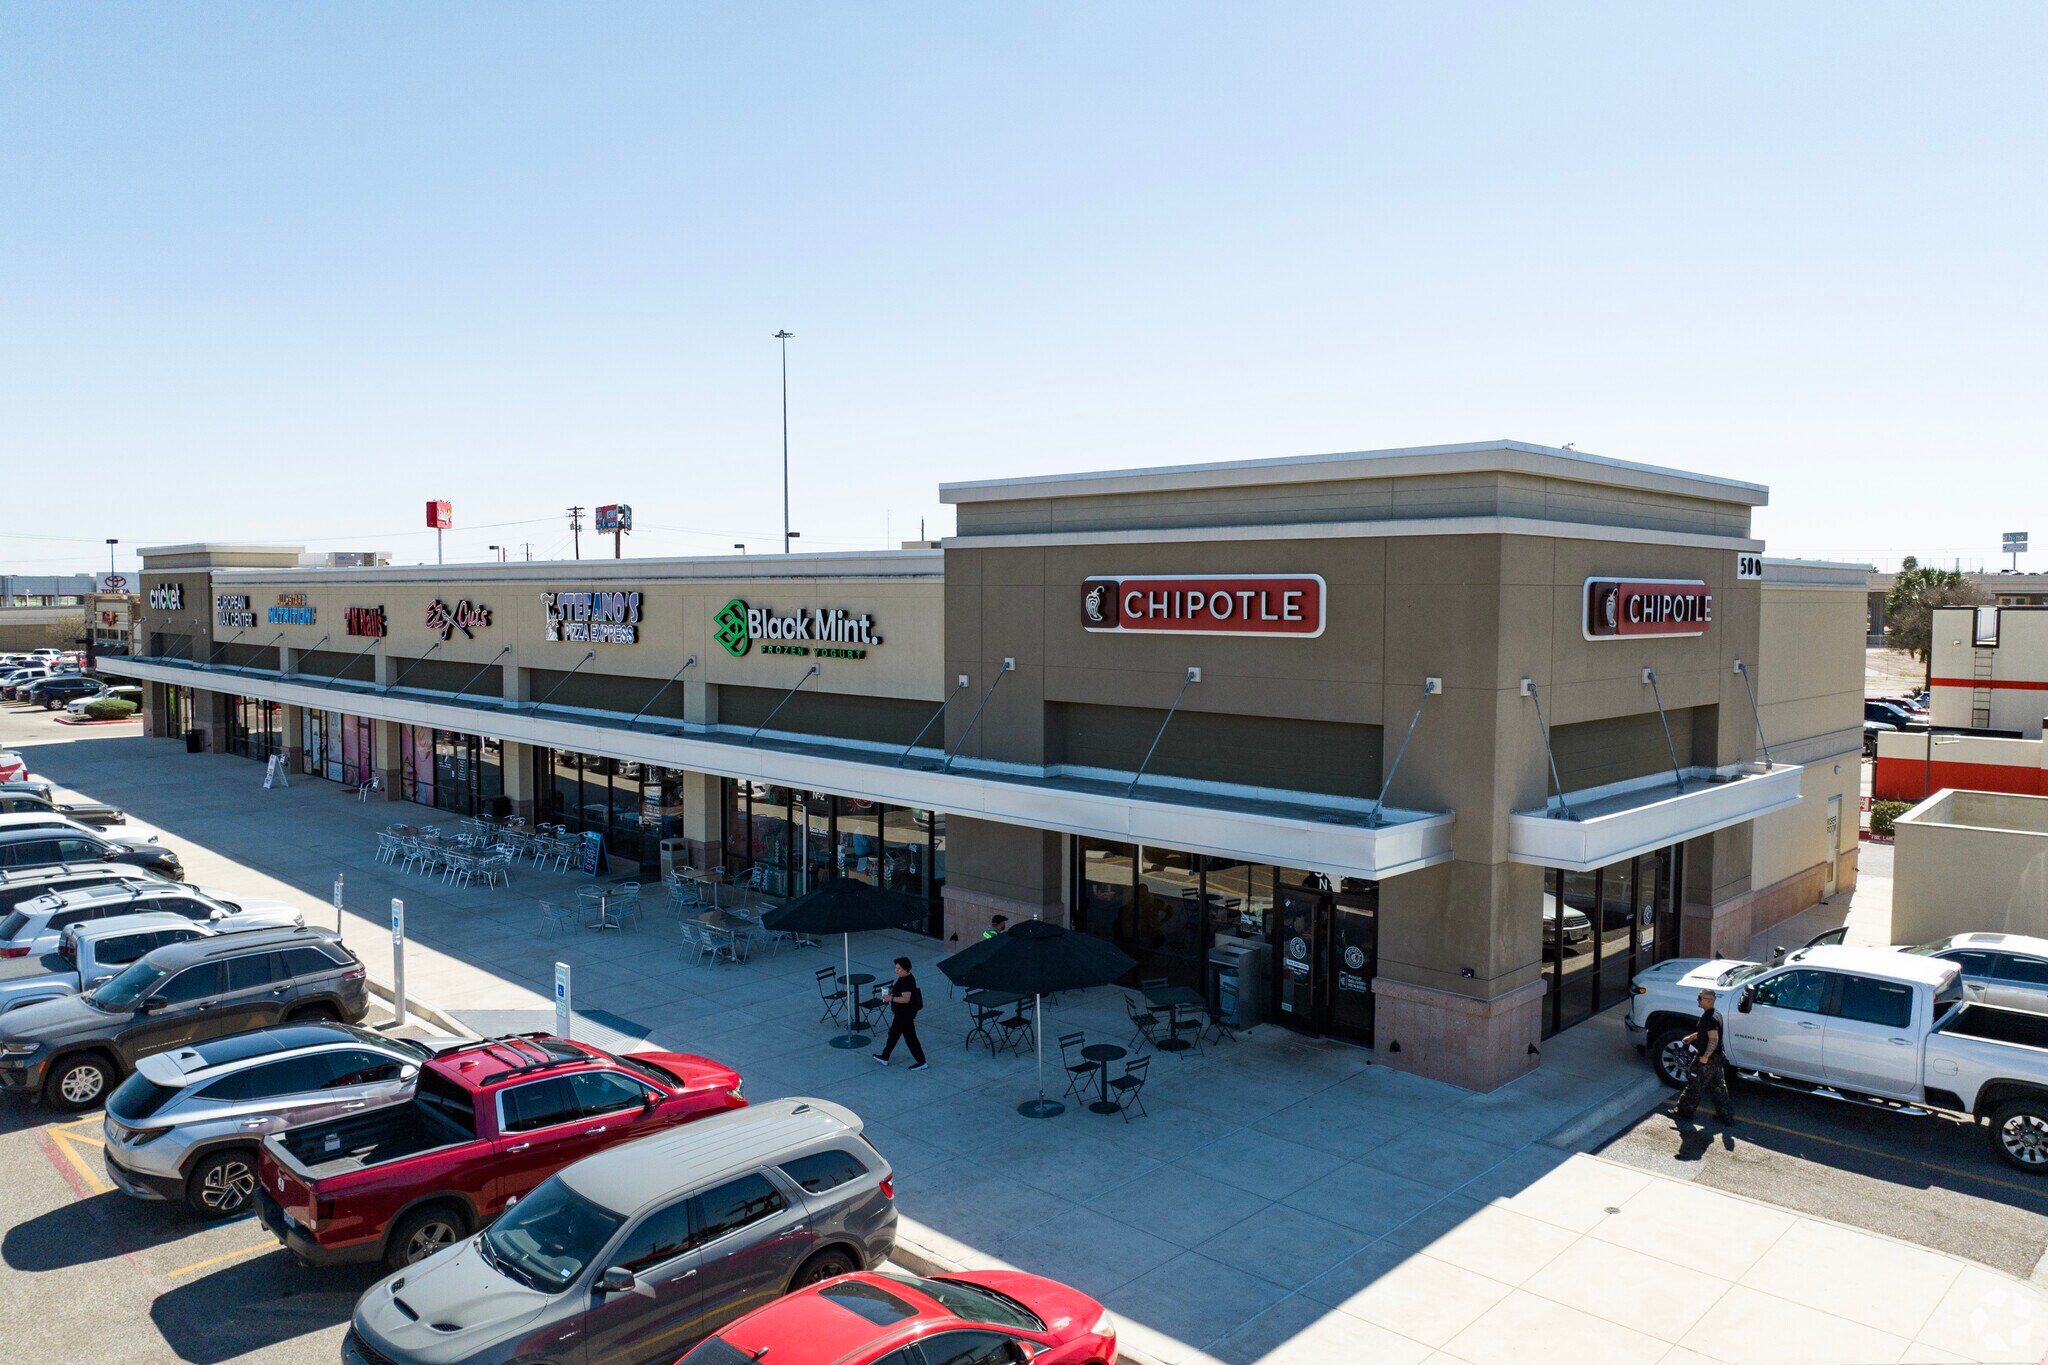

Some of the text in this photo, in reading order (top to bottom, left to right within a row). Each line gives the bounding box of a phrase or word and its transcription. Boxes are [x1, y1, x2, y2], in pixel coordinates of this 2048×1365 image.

[1740, 557, 1762, 576] 500
[150, 583, 181, 610] cricket
[217, 595, 246, 609] EUROPEAN
[556, 591, 639, 623] STEFANO'S
[1124, 590, 1303, 621] CHIPOTLE
[1629, 594, 1713, 624] CHIPOTLE
[218, 611, 253, 627] WAX CENTER
[268, 607, 313, 625] NUTRITION
[459, 600, 488, 628] Cuts
[564, 622, 635, 645] PIZZA EXPRESS
[747, 608, 879, 646] Black Mint.
[760, 645, 862, 659] FROZEN YOGURT
